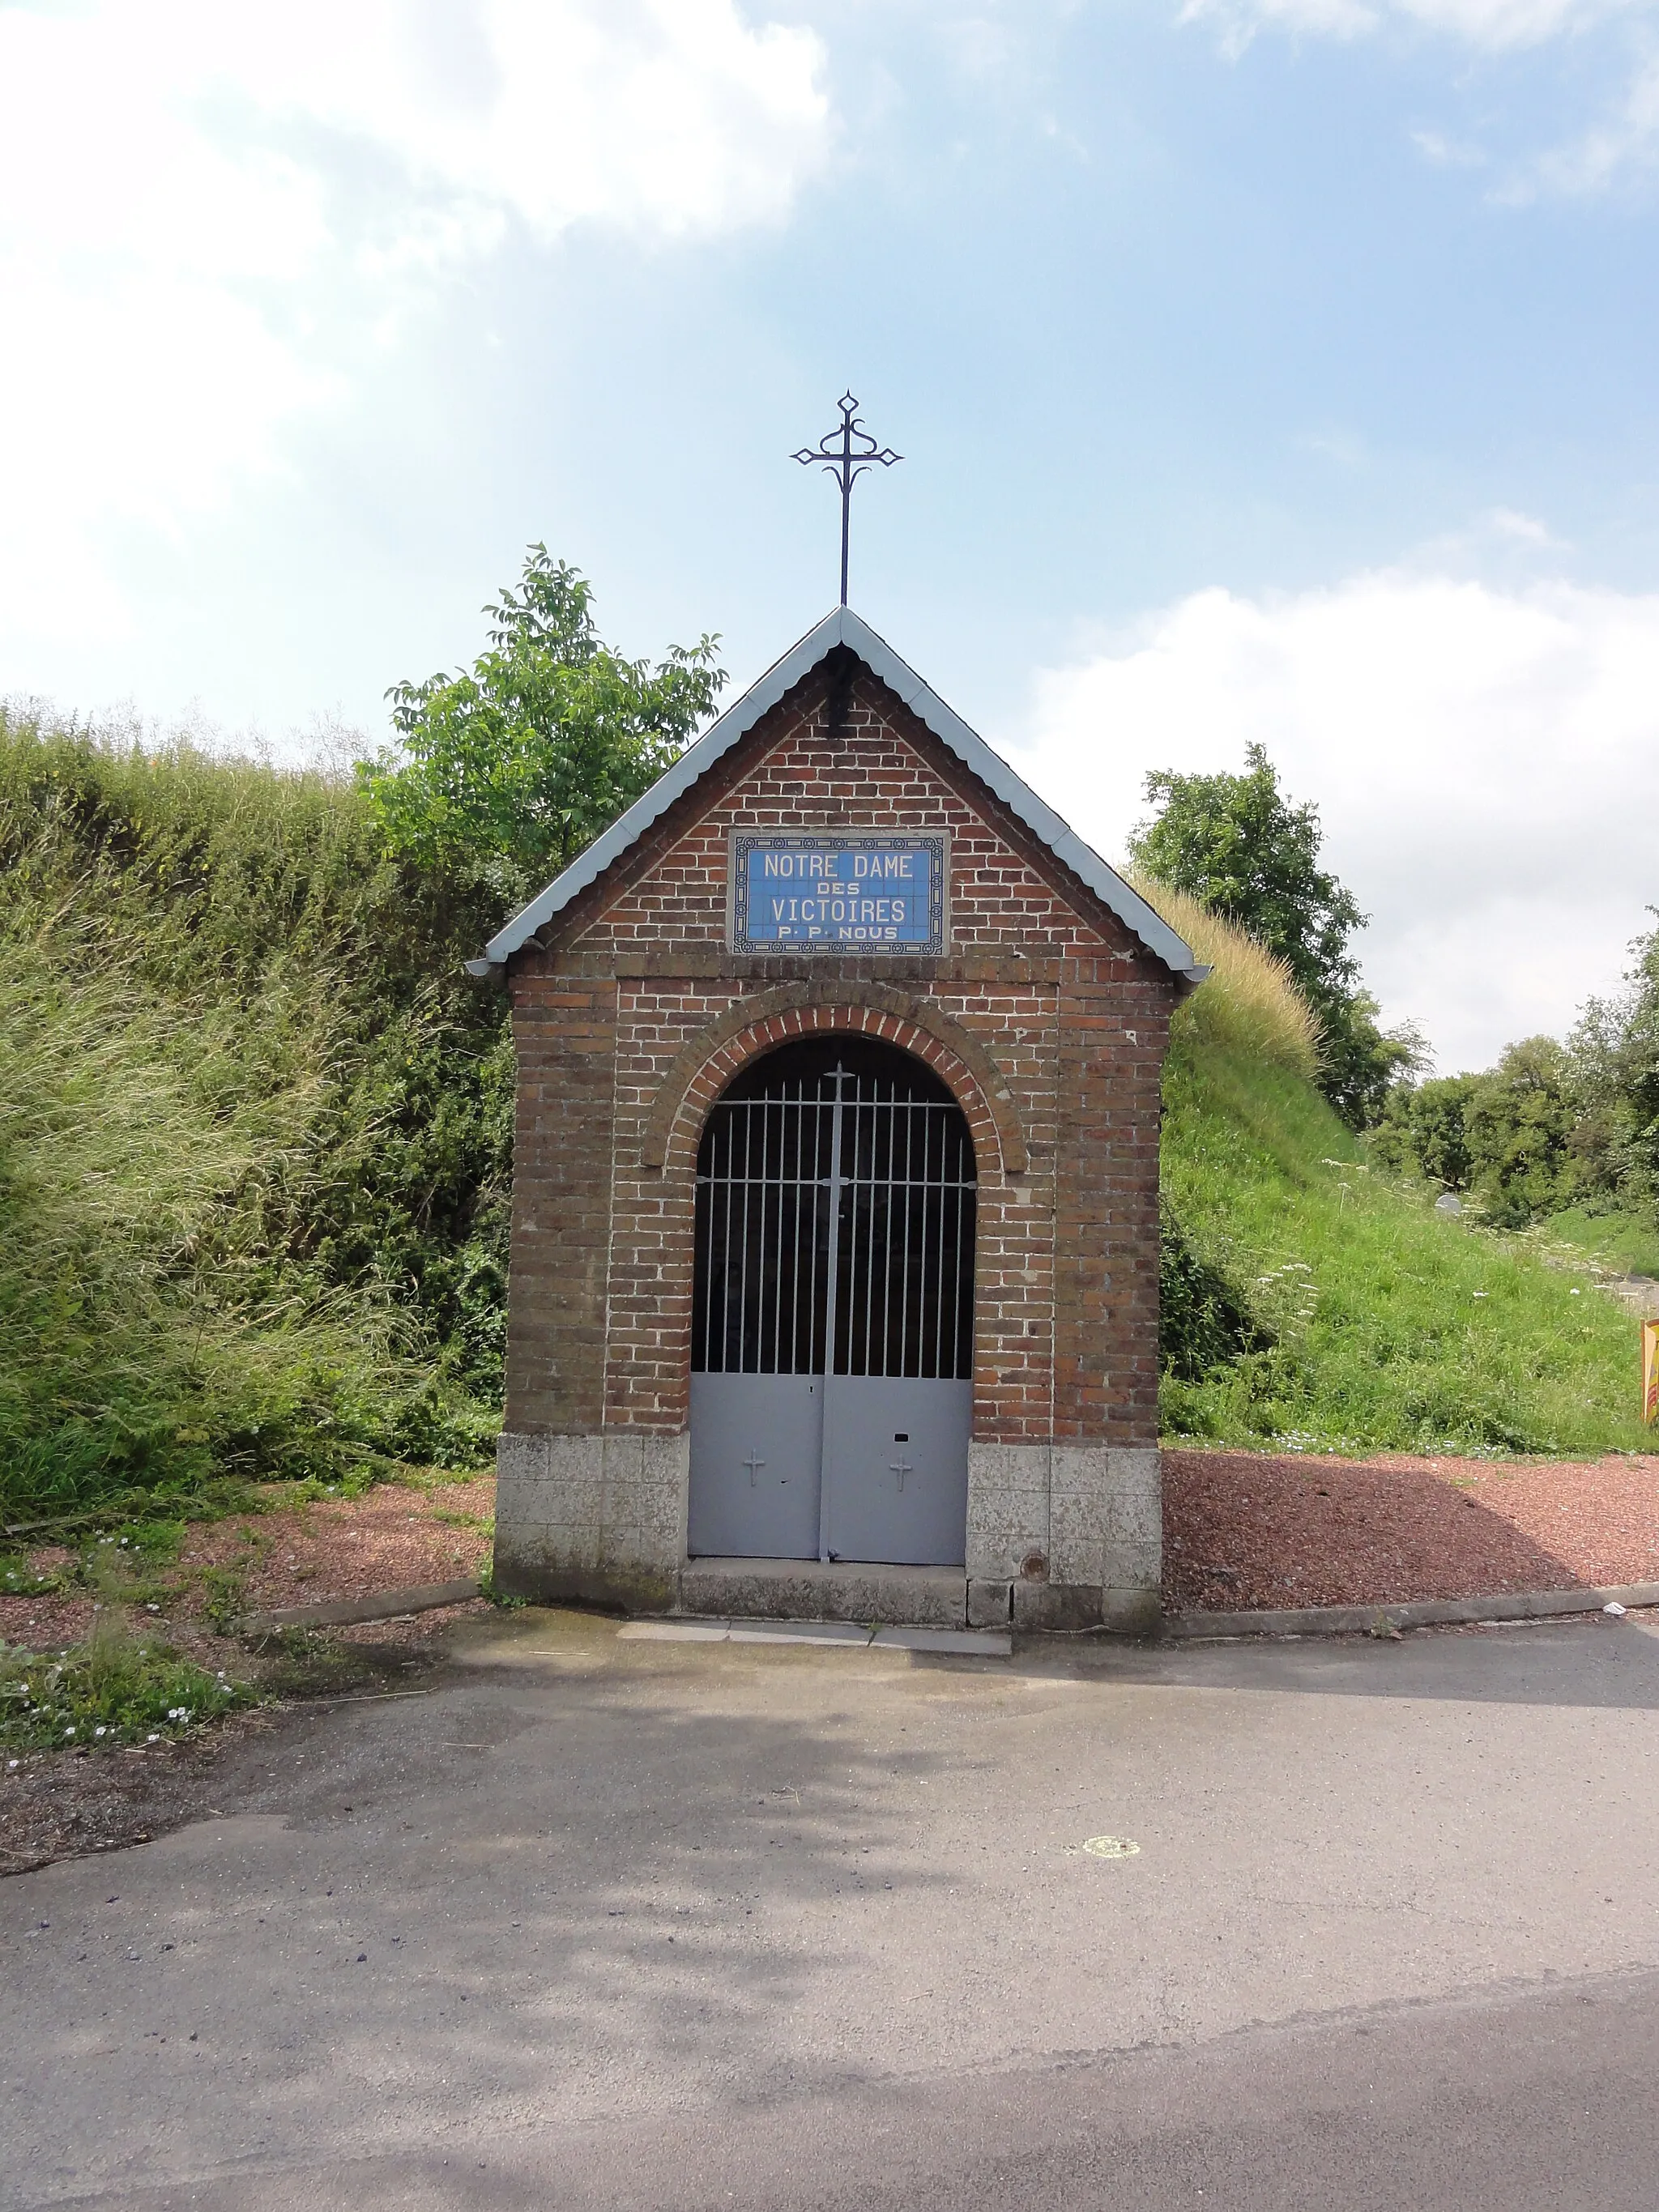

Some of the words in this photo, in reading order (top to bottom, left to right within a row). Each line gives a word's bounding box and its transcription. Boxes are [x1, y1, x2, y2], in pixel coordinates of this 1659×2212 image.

[765, 855, 838, 877] NOTRE
[854, 855, 913, 877] DAME
[817, 882, 859, 895] DES
[772, 899, 905, 923] VICTOIRES
[838, 927, 898, 940] NOUS
